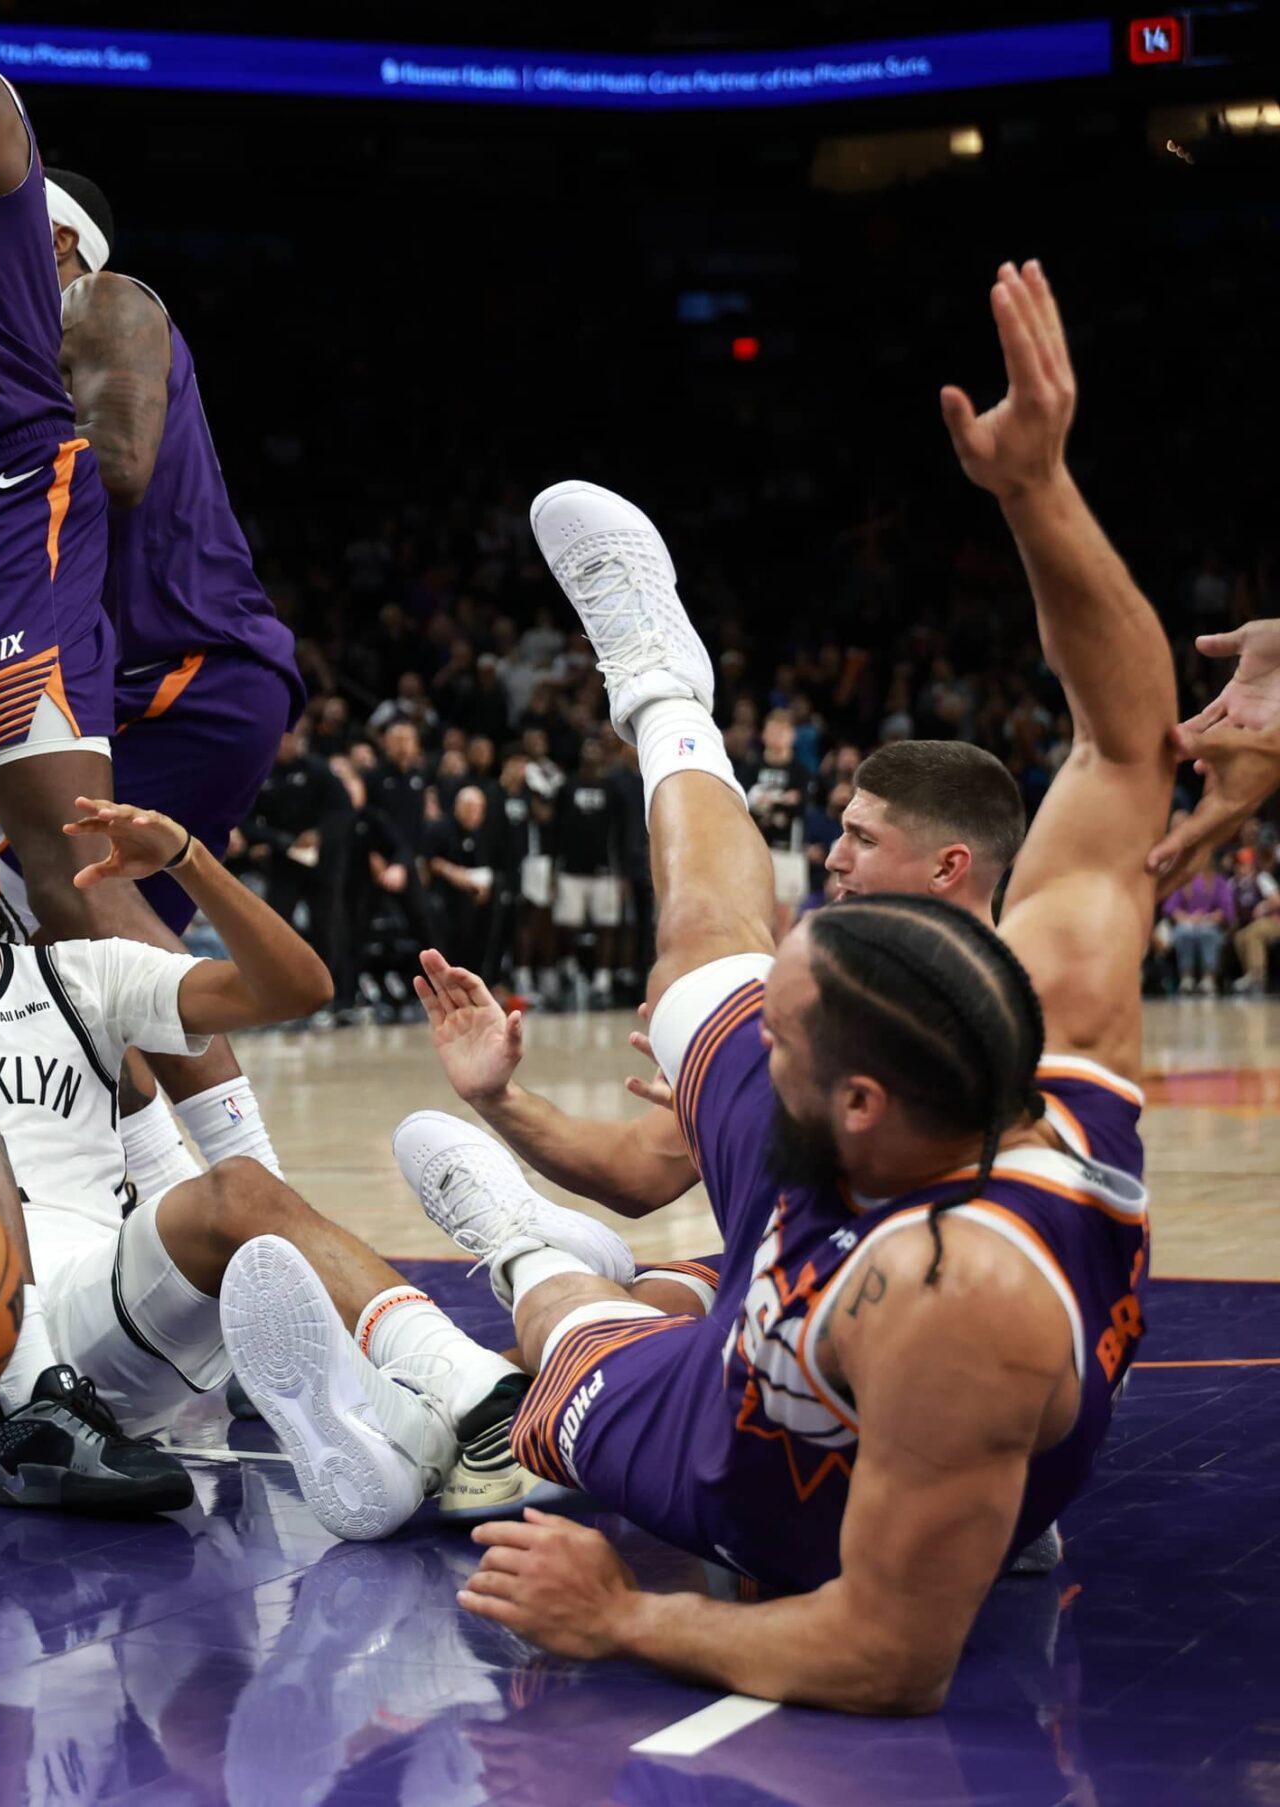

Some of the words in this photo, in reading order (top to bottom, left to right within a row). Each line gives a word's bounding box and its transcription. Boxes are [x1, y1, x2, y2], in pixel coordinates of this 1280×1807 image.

[1142, 25, 1170, 54] 14
[0, 1011, 14, 1023] All
[15, 1008, 26, 1020] In
[25, 1000, 51, 1016] Won
